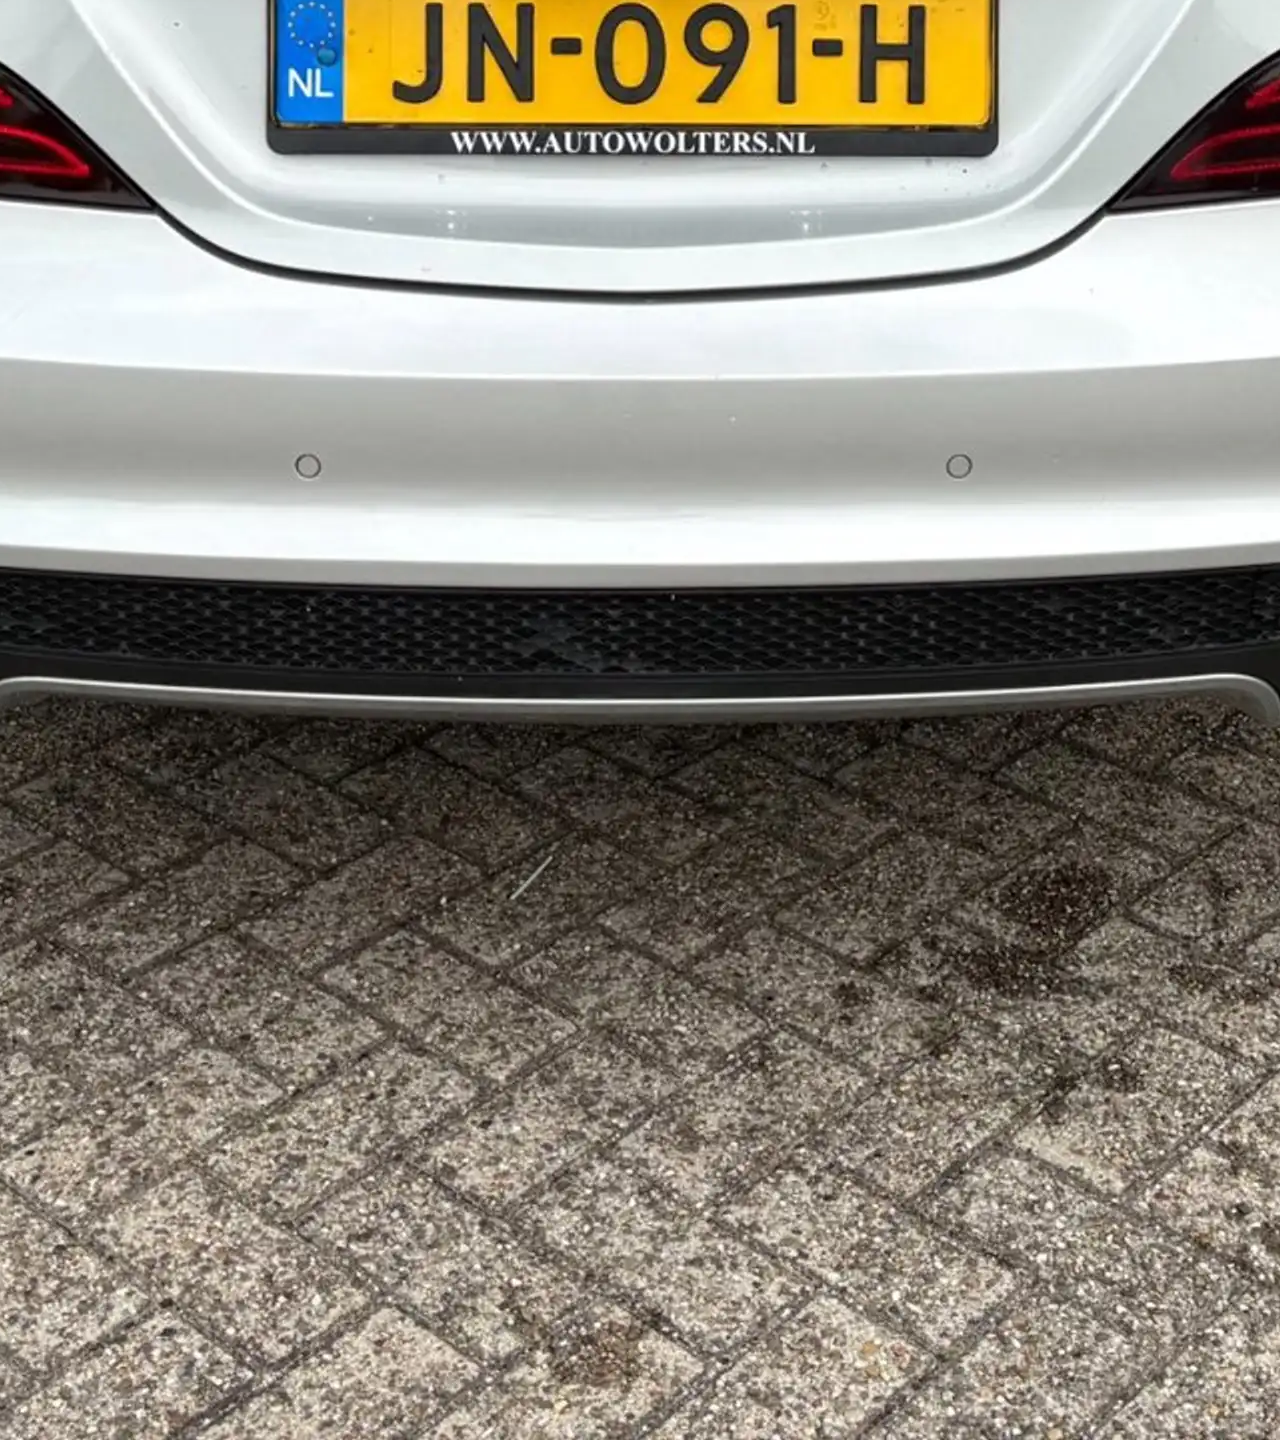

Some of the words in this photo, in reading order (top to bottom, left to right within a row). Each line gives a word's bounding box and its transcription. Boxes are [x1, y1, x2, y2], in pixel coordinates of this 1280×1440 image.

[391, 2, 926, 105] JN-091-H
[288, 68, 335, 98] NL
[450, 131, 816, 154] WWW.AUTOWOLTERS.NL
